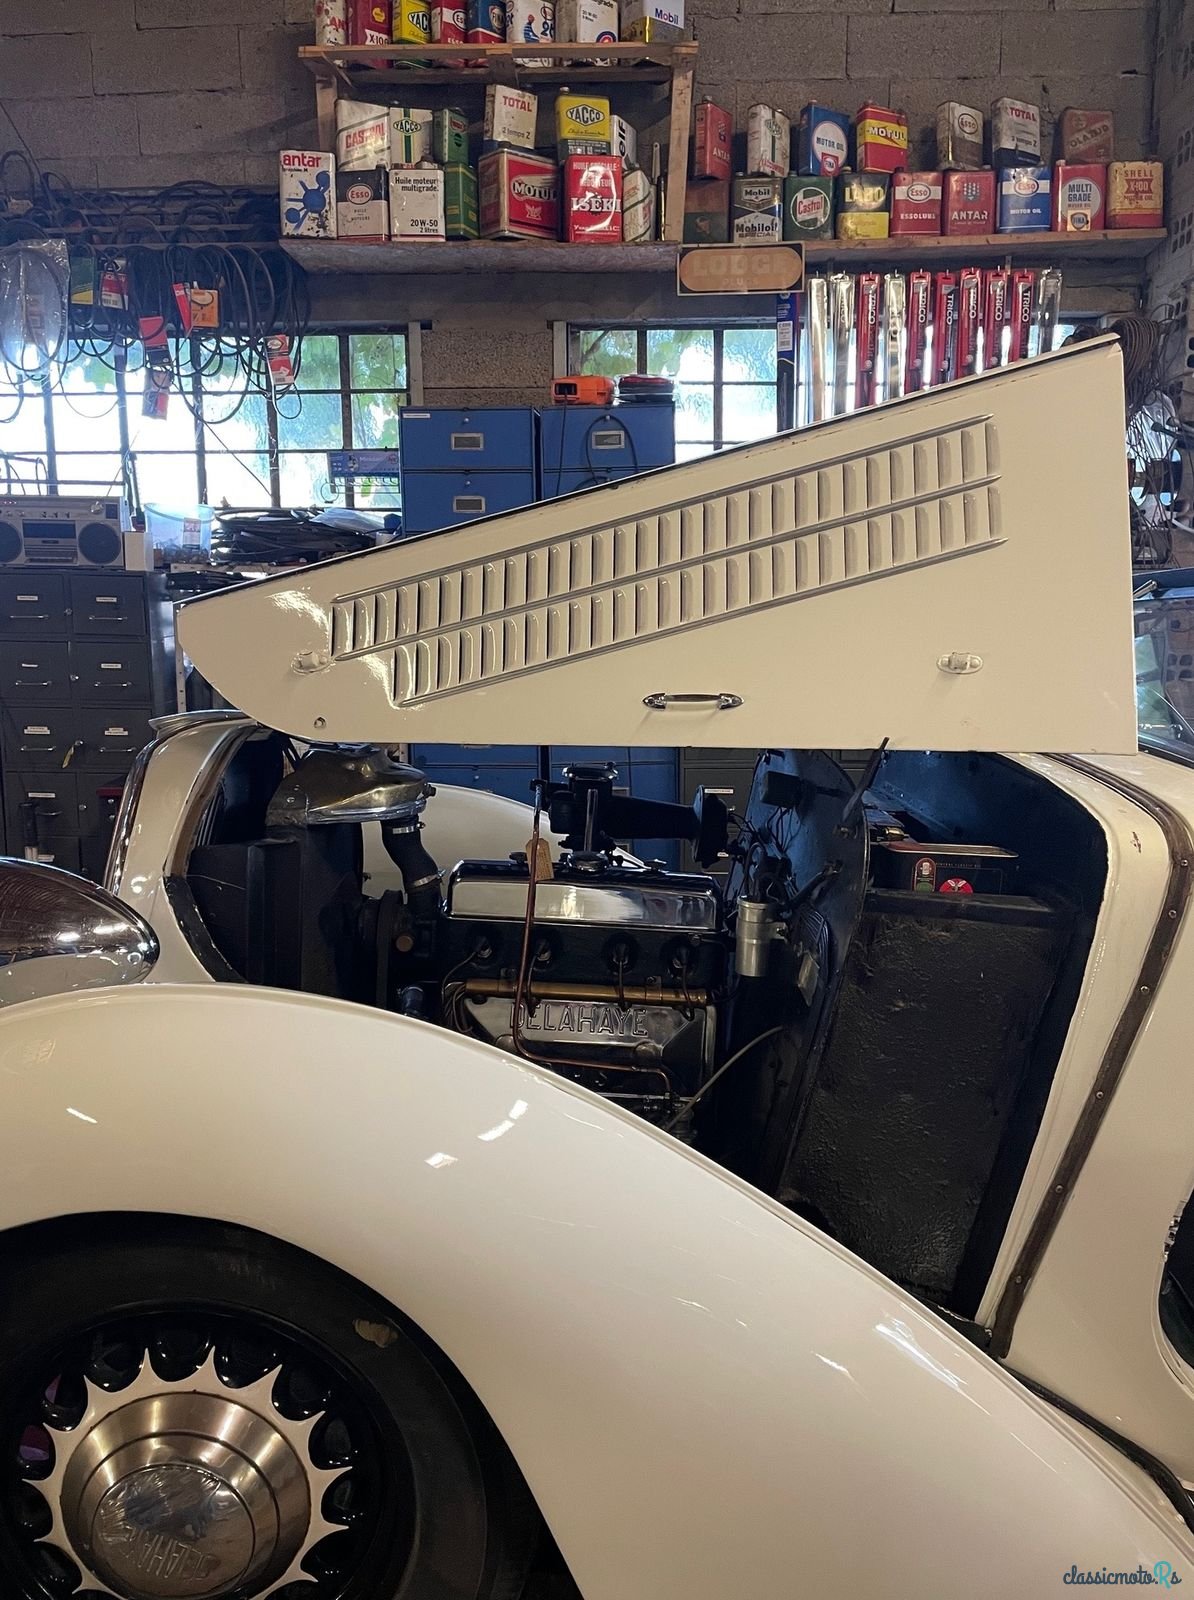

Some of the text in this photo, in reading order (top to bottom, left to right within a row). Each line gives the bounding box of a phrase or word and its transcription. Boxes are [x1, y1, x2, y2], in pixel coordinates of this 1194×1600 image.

[410, 13, 429, 31] YAC
[655, 8, 679, 25] Mobil
[502, 95, 532, 112] TOTAL
[568, 106, 601, 124] YACCO
[1009, 107, 1037, 121] TOTAL
[395, 120, 419, 133] YACCO
[869, 126, 905, 140] MOTUL
[816, 136, 835, 149] MOTOR
[282, 153, 321, 168] antar
[1124, 169, 1154, 177] SHELL
[413, 177, 436, 185] moteur
[514, 181, 557, 201] MOTUL
[744, 189, 770, 197] Mobil
[910, 188, 928, 197] Esso
[1068, 184, 1092, 193] MULTI
[571, 197, 622, 212] ISEKI
[1068, 193, 1092, 202] GRADE
[797, 196, 823, 215] Castrol
[951, 210, 988, 221] ANTAR
[735, 222, 778, 233] Mobiloil
[969, 288, 977, 319] TRICO
[995, 289, 1003, 321] TRICO
[1022, 290, 1030, 322] TRICO
[509, 1001, 648, 1037] DELAHAYE
